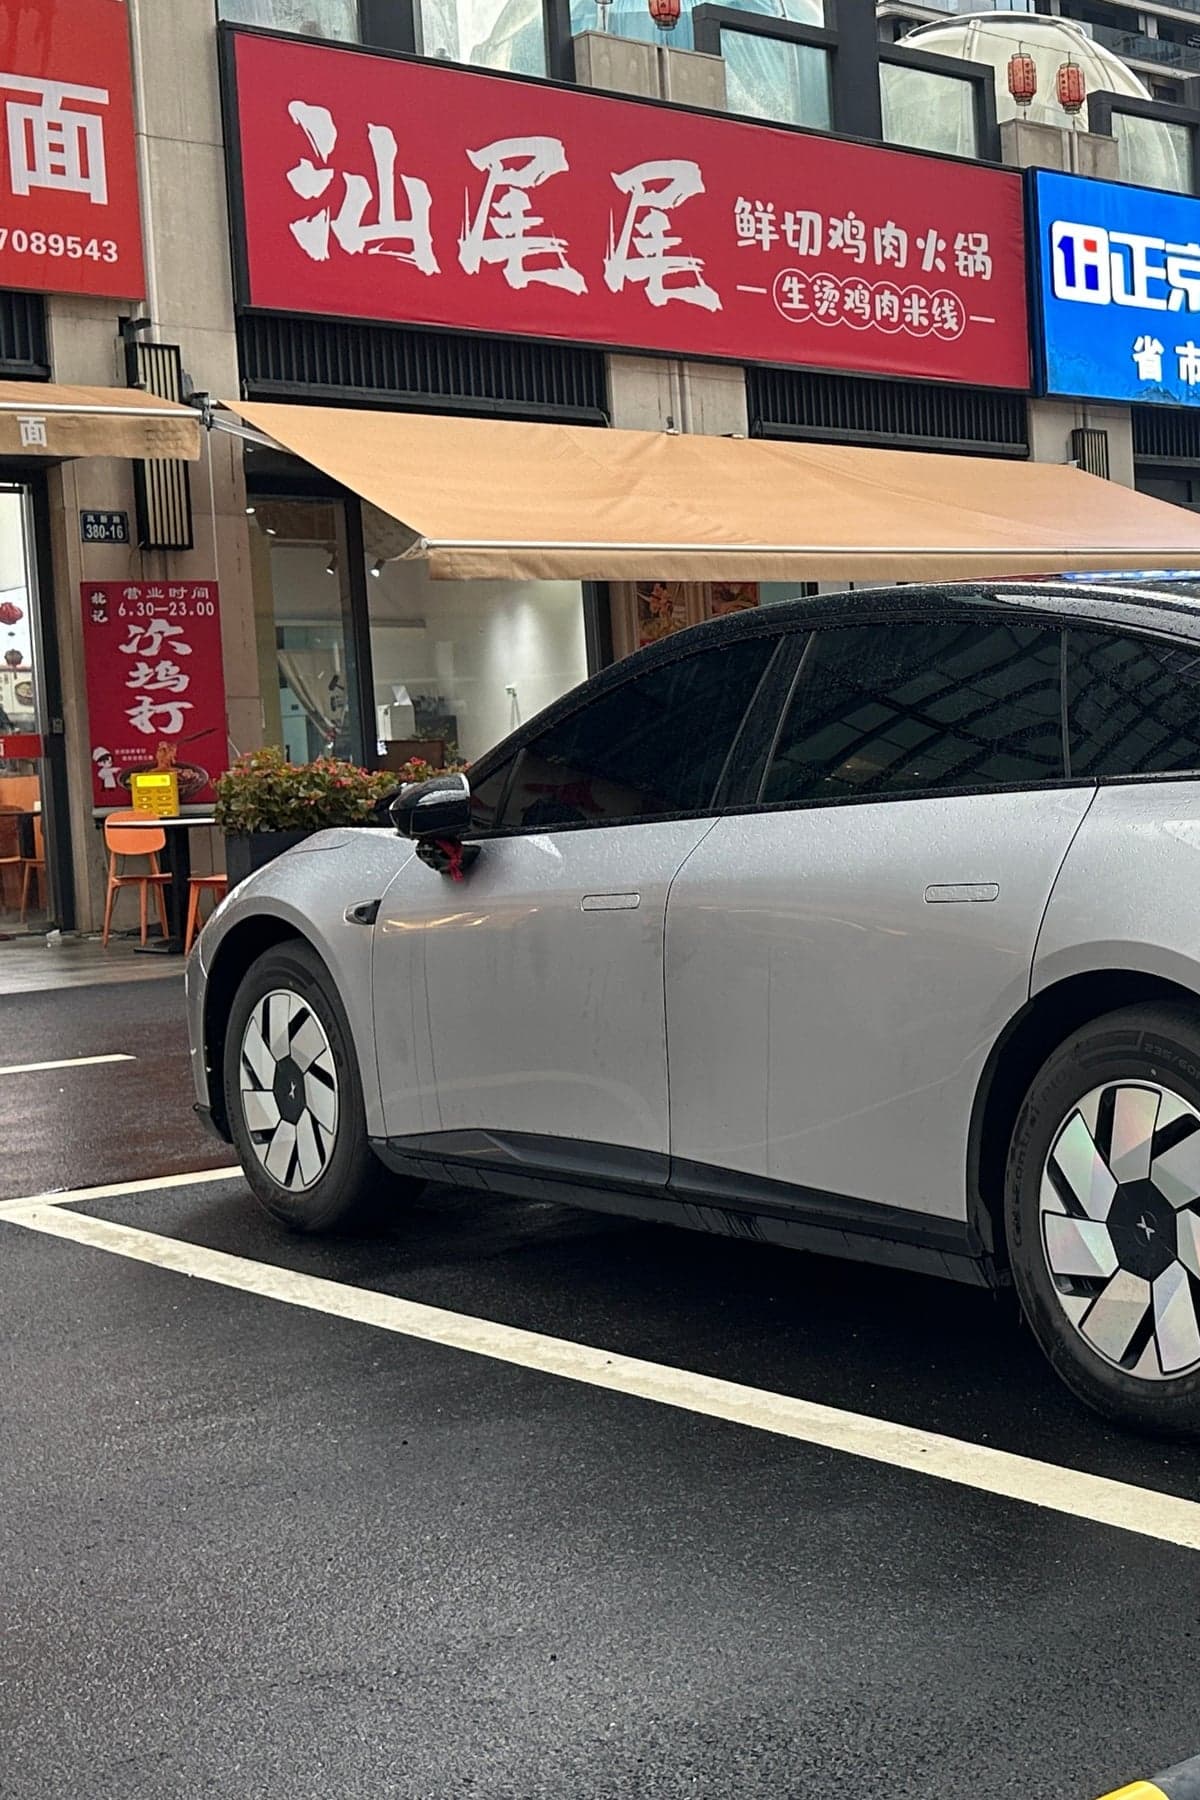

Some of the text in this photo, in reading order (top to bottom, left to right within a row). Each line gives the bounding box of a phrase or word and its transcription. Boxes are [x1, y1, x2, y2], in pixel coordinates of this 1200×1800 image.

[0, 72, 109, 205] 面
[286, 100, 724, 312] 汕尾尾
[734, 196, 993, 281] 鲜切鸡肉火锅
[781, 275, 959, 332] 生烫鸡肉米线
[17, 416, 48, 447] 面
[86, 524, 124, 540] 380-16
[123, 586, 209, 600] 营业时间
[118, 618, 195, 735] 次坞打
